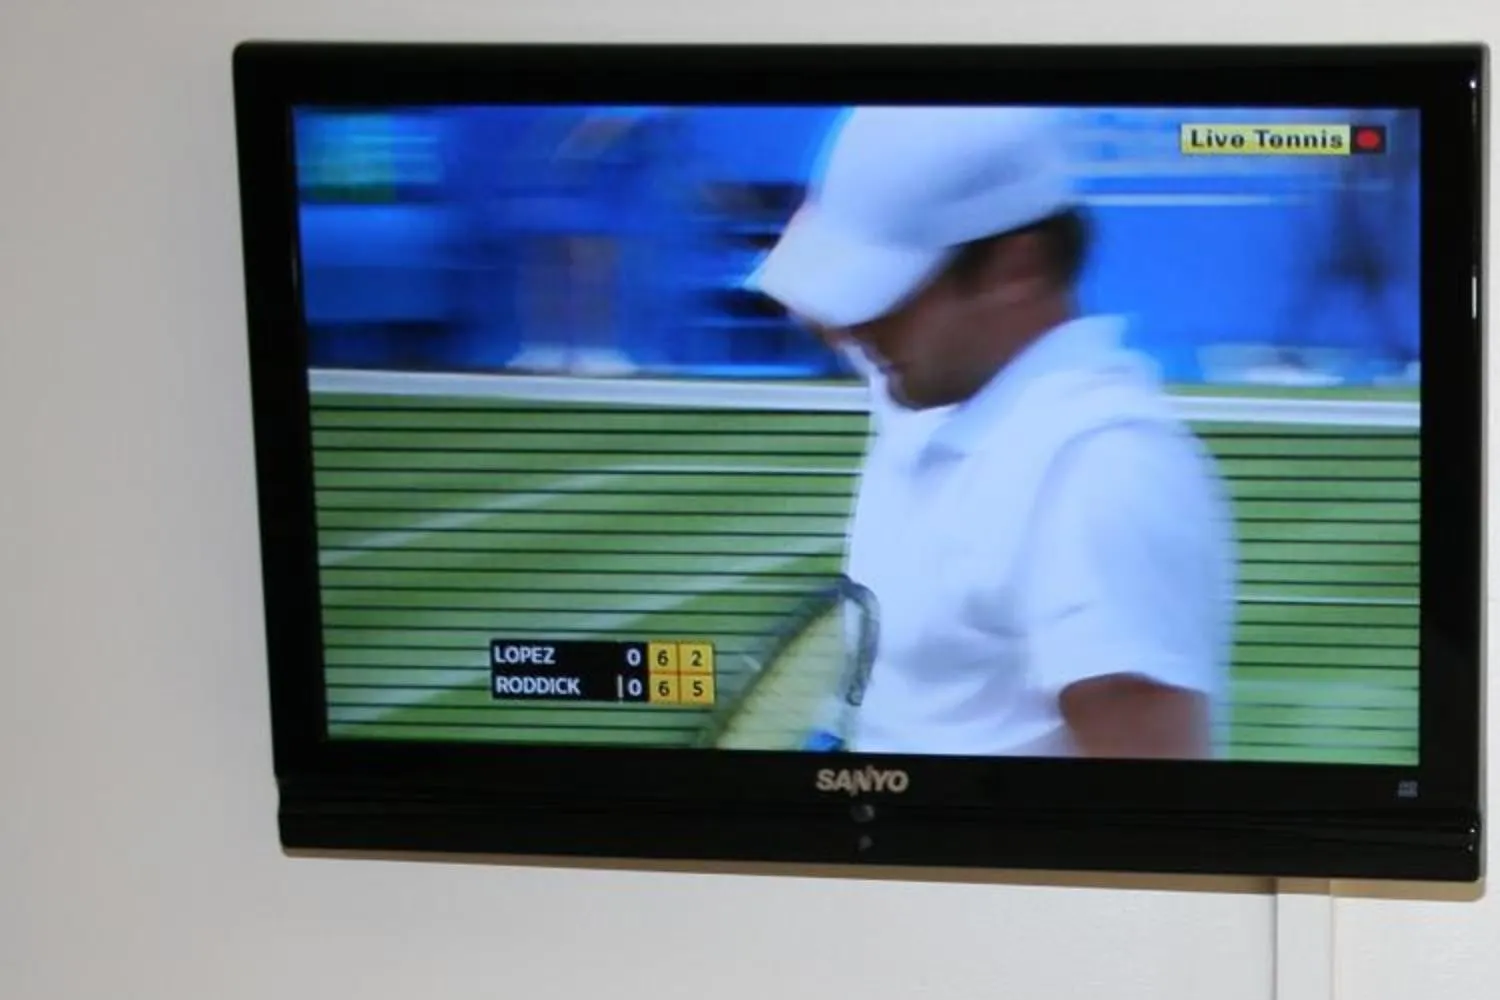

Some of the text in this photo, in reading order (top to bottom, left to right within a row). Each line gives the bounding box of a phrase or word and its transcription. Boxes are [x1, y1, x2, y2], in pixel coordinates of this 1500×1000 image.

[1190, 129, 1344, 149] Live Tennis
[494, 646, 704, 667] LOPEZ 0 6 2
[495, 676, 581, 696] RODDICK
[657, 681, 671, 698] 6
[692, 681, 704, 698] 5
[816, 766, 909, 795] SANYO
